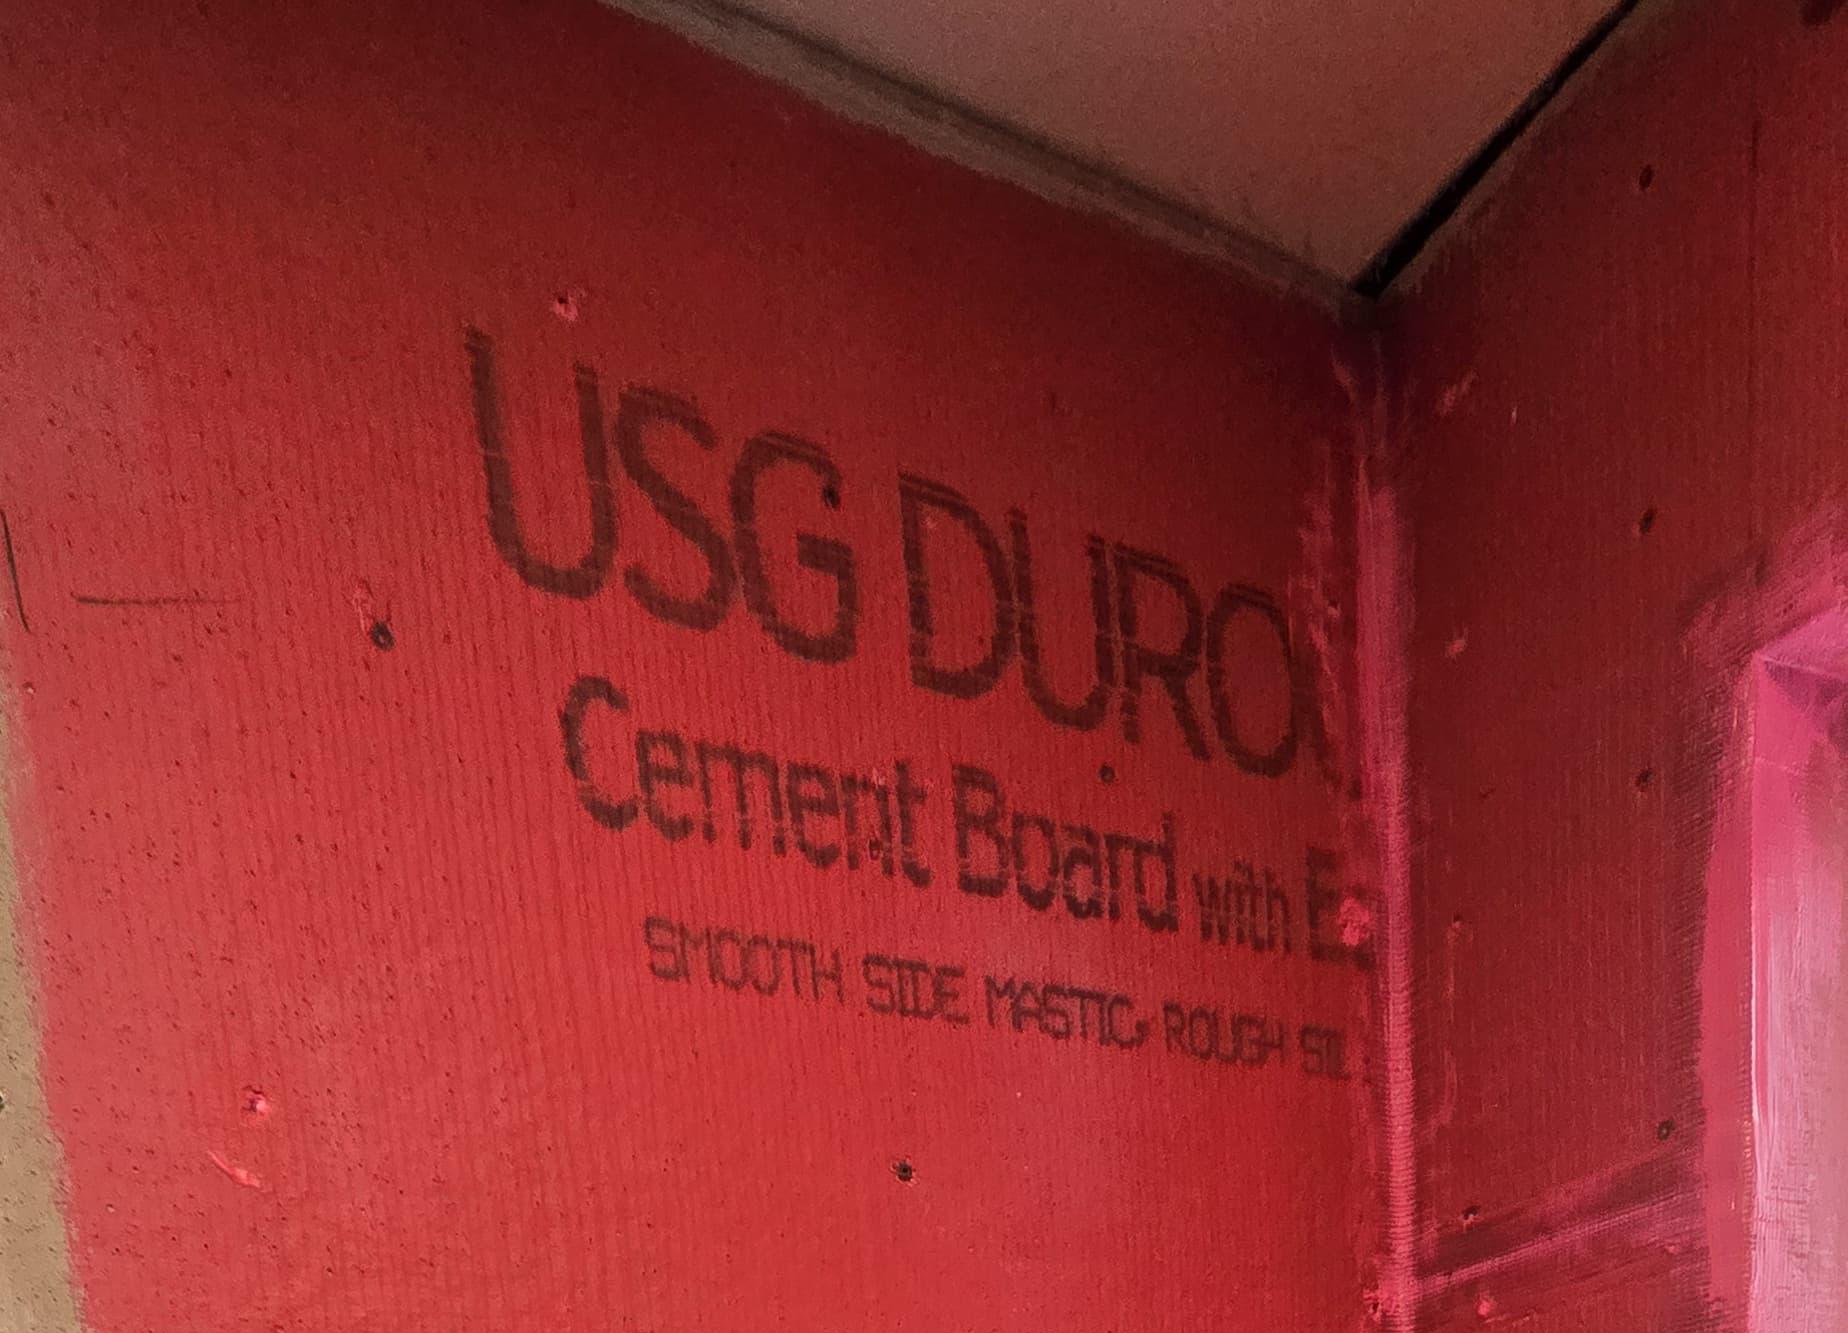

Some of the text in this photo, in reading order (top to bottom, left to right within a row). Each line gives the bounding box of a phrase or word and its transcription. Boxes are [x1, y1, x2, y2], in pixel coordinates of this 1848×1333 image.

[466, 328, 857, 663] USG
[562, 676, 930, 888] Cement
[951, 764, 1178, 933] Board
[1191, 858, 1293, 957] with
[644, 916, 843, 1003] SMOOTH
[861, 951, 969, 1025] SIDE
[1162, 1003, 1286, 1067] ROUGH
